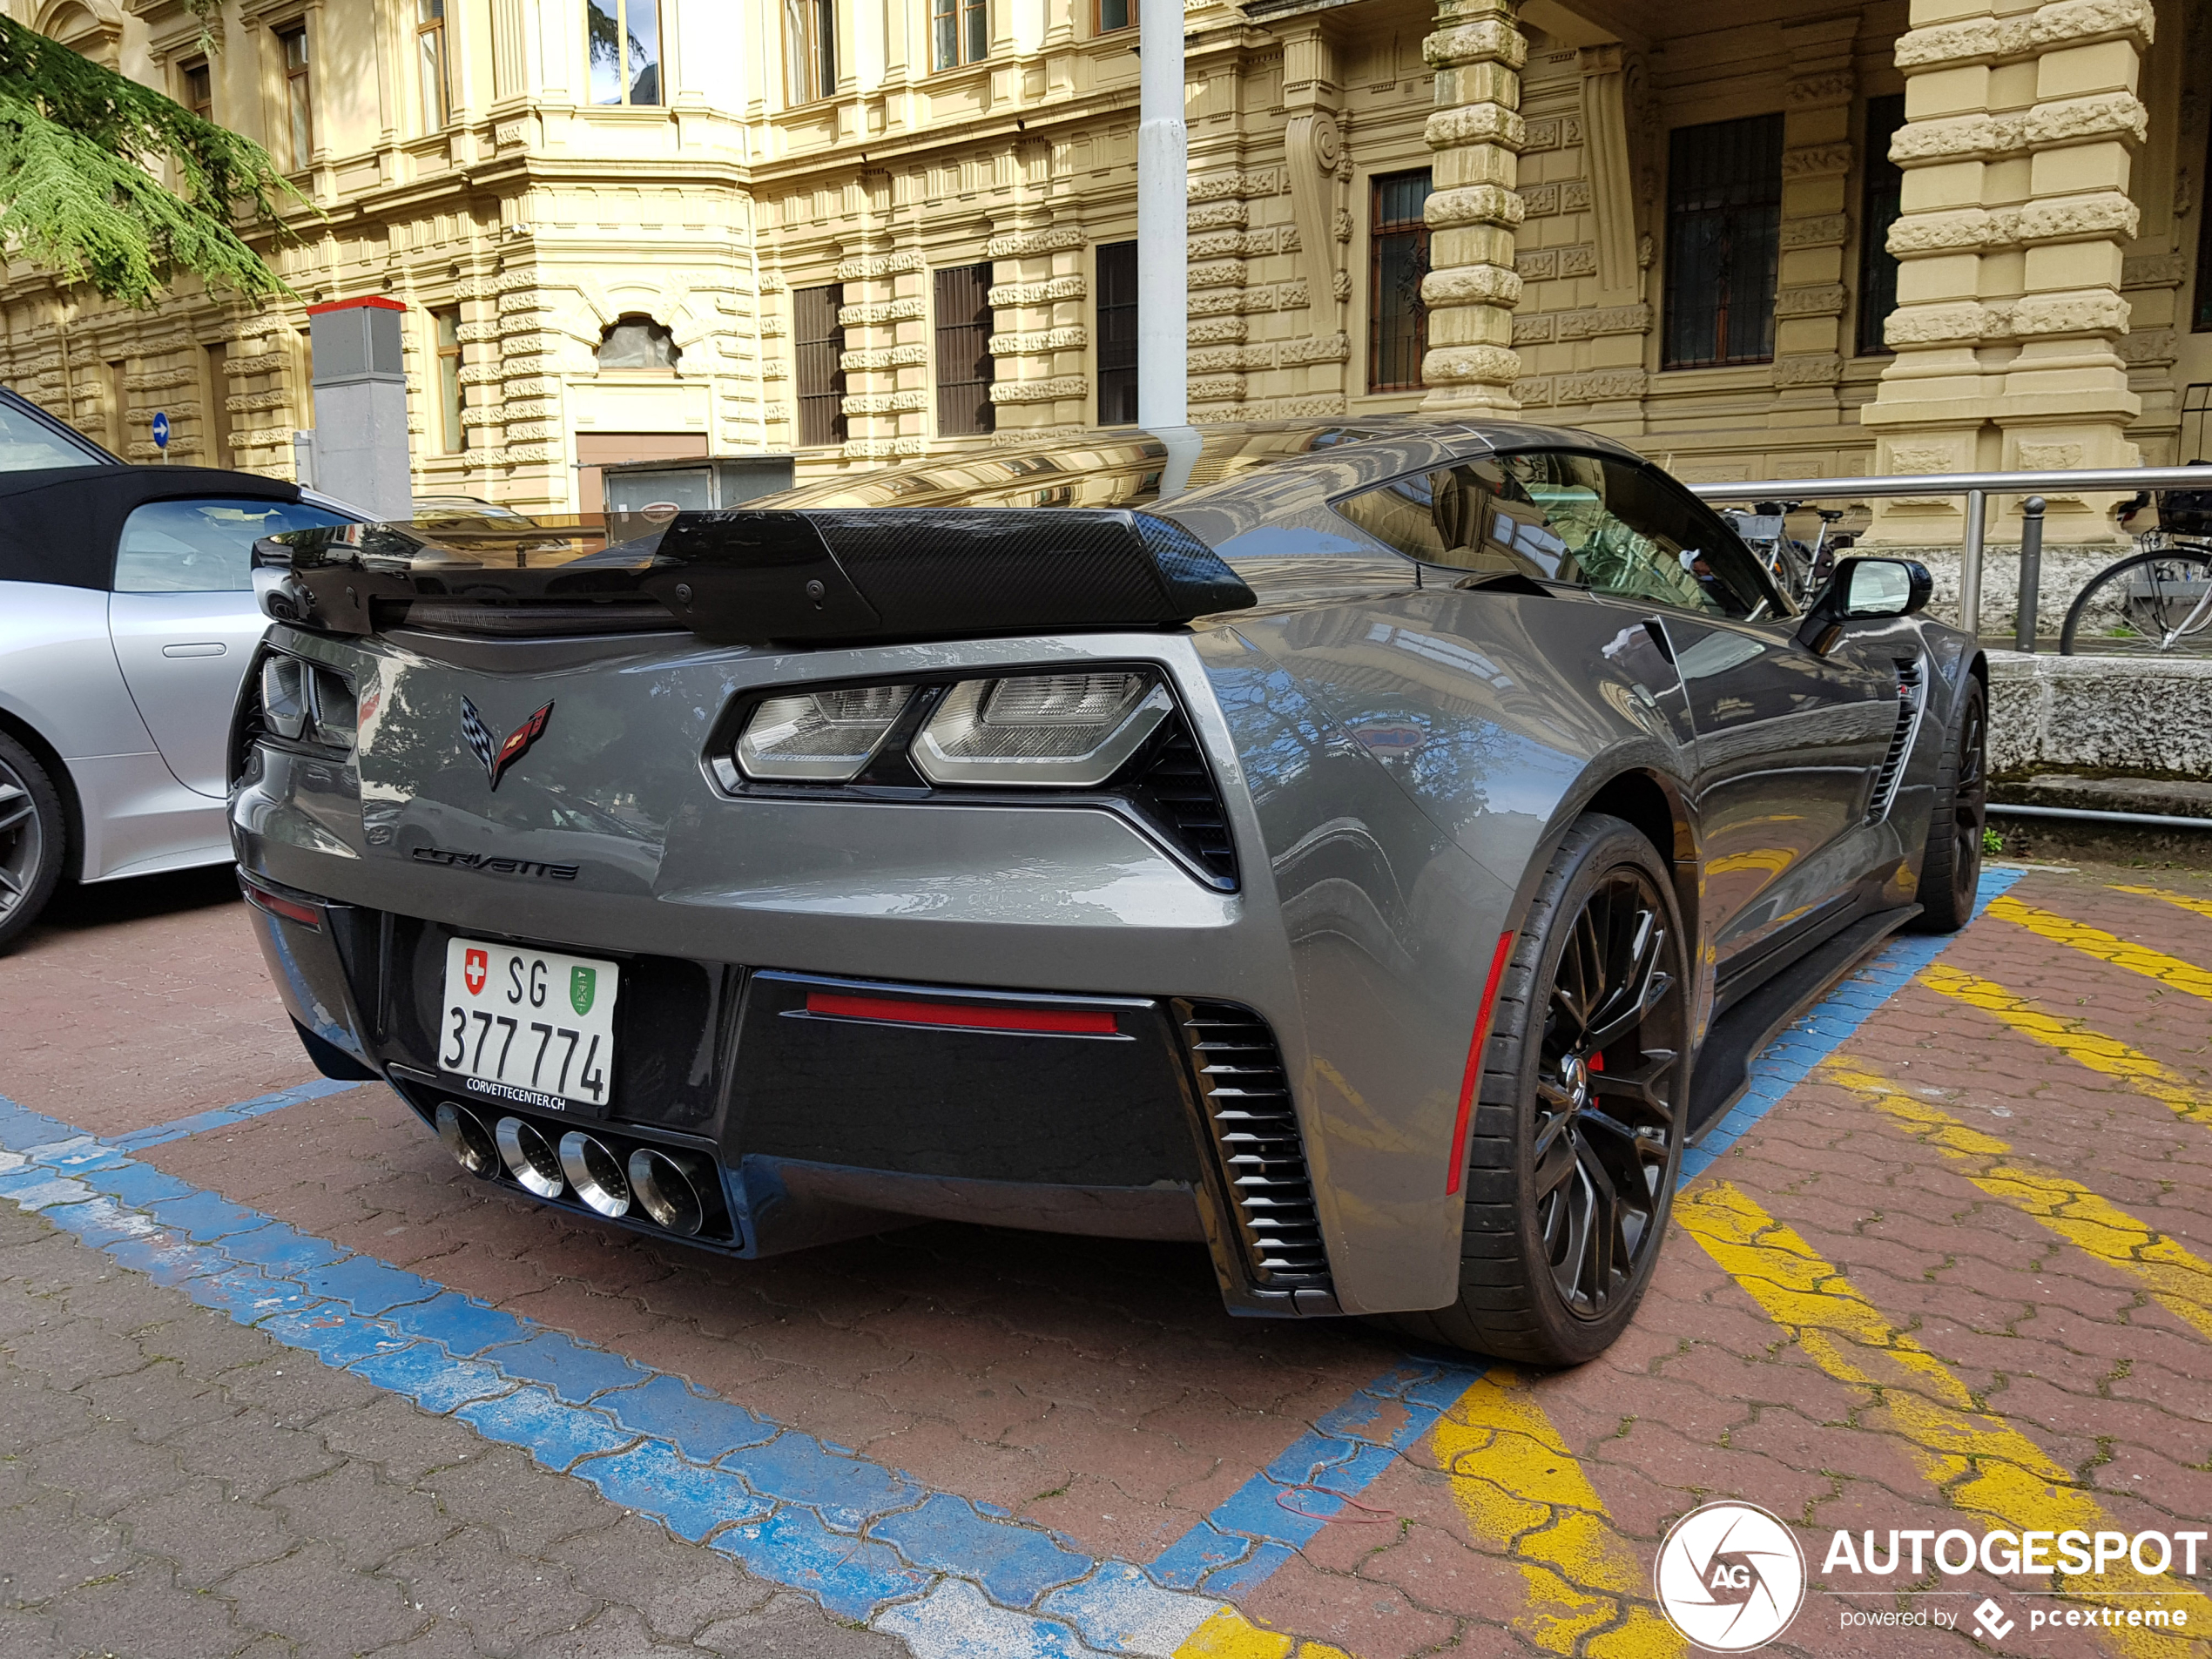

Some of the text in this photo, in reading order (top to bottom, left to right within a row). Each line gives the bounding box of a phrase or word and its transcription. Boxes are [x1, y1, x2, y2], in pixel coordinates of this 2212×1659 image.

[412, 846, 580, 880] CORVETTE
[507, 956, 548, 1008] SG
[466, 1077, 566, 1111] CORVETTECENTER.CH
